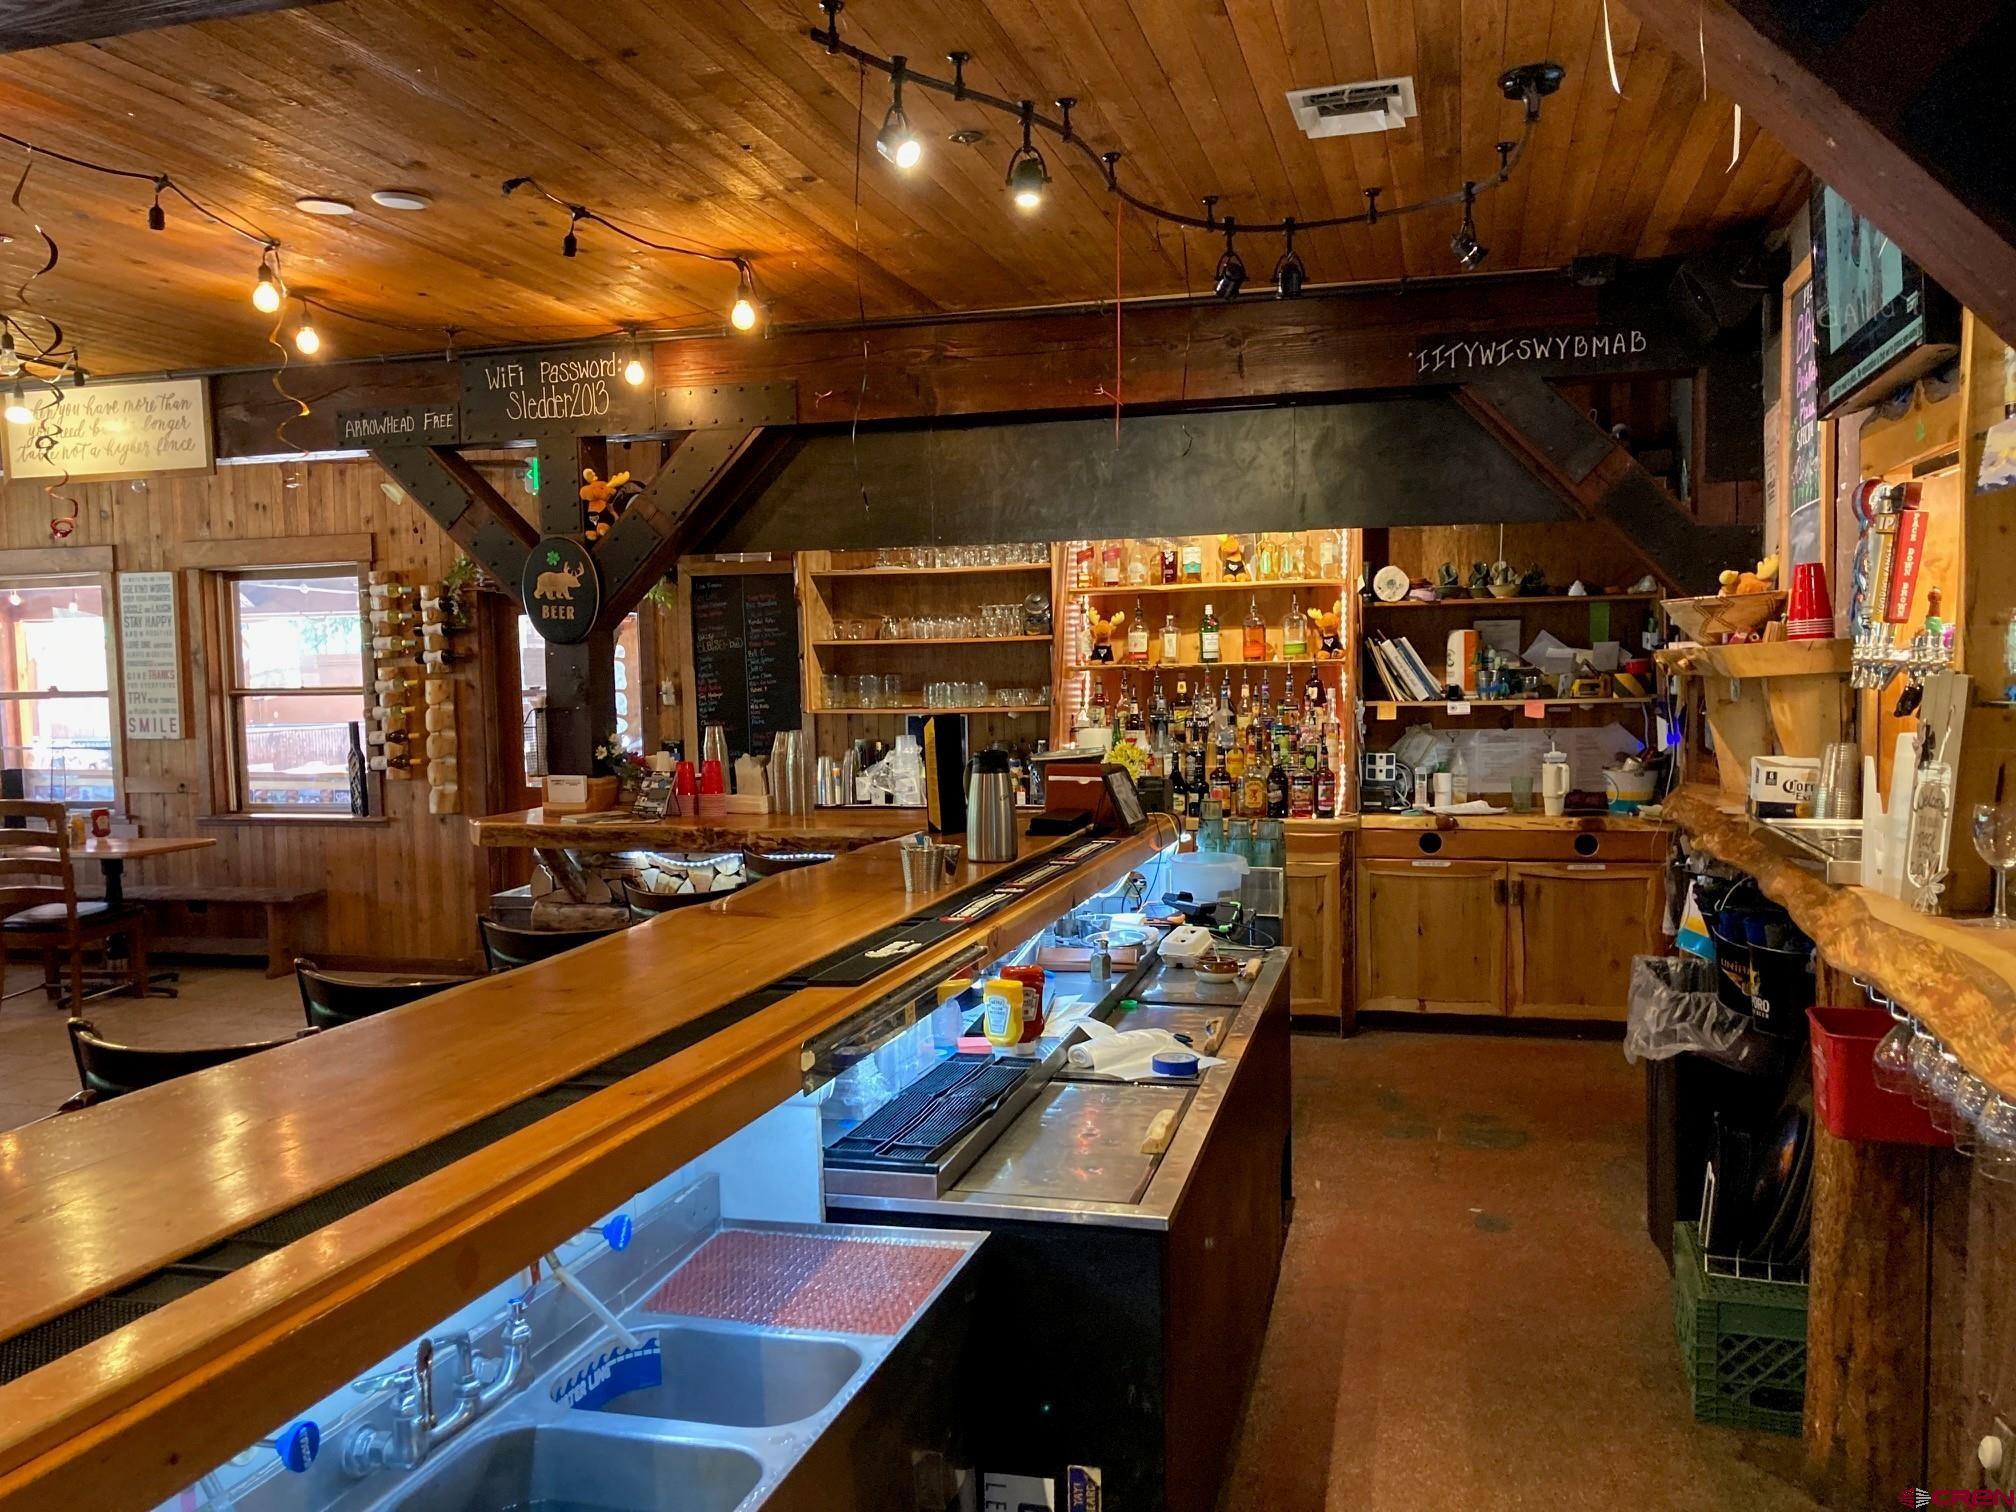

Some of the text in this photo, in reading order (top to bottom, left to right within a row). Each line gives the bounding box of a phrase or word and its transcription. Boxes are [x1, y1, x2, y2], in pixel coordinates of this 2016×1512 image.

[485, 364, 524, 391] WiFi
[82, 394, 120, 416] have
[122, 396, 157, 414] more
[142, 415, 192, 435] longer
[345, 412, 454, 438] ARROWHEAD FREE
[1904, 547, 1915, 577] DOWN
[1897, 582, 1909, 618] BROWN
[123, 615, 171, 628] STAY HAPPY
[542, 604, 575, 620] BEER
[128, 691, 148, 704] TRY
[128, 717, 177, 733] SMILE
